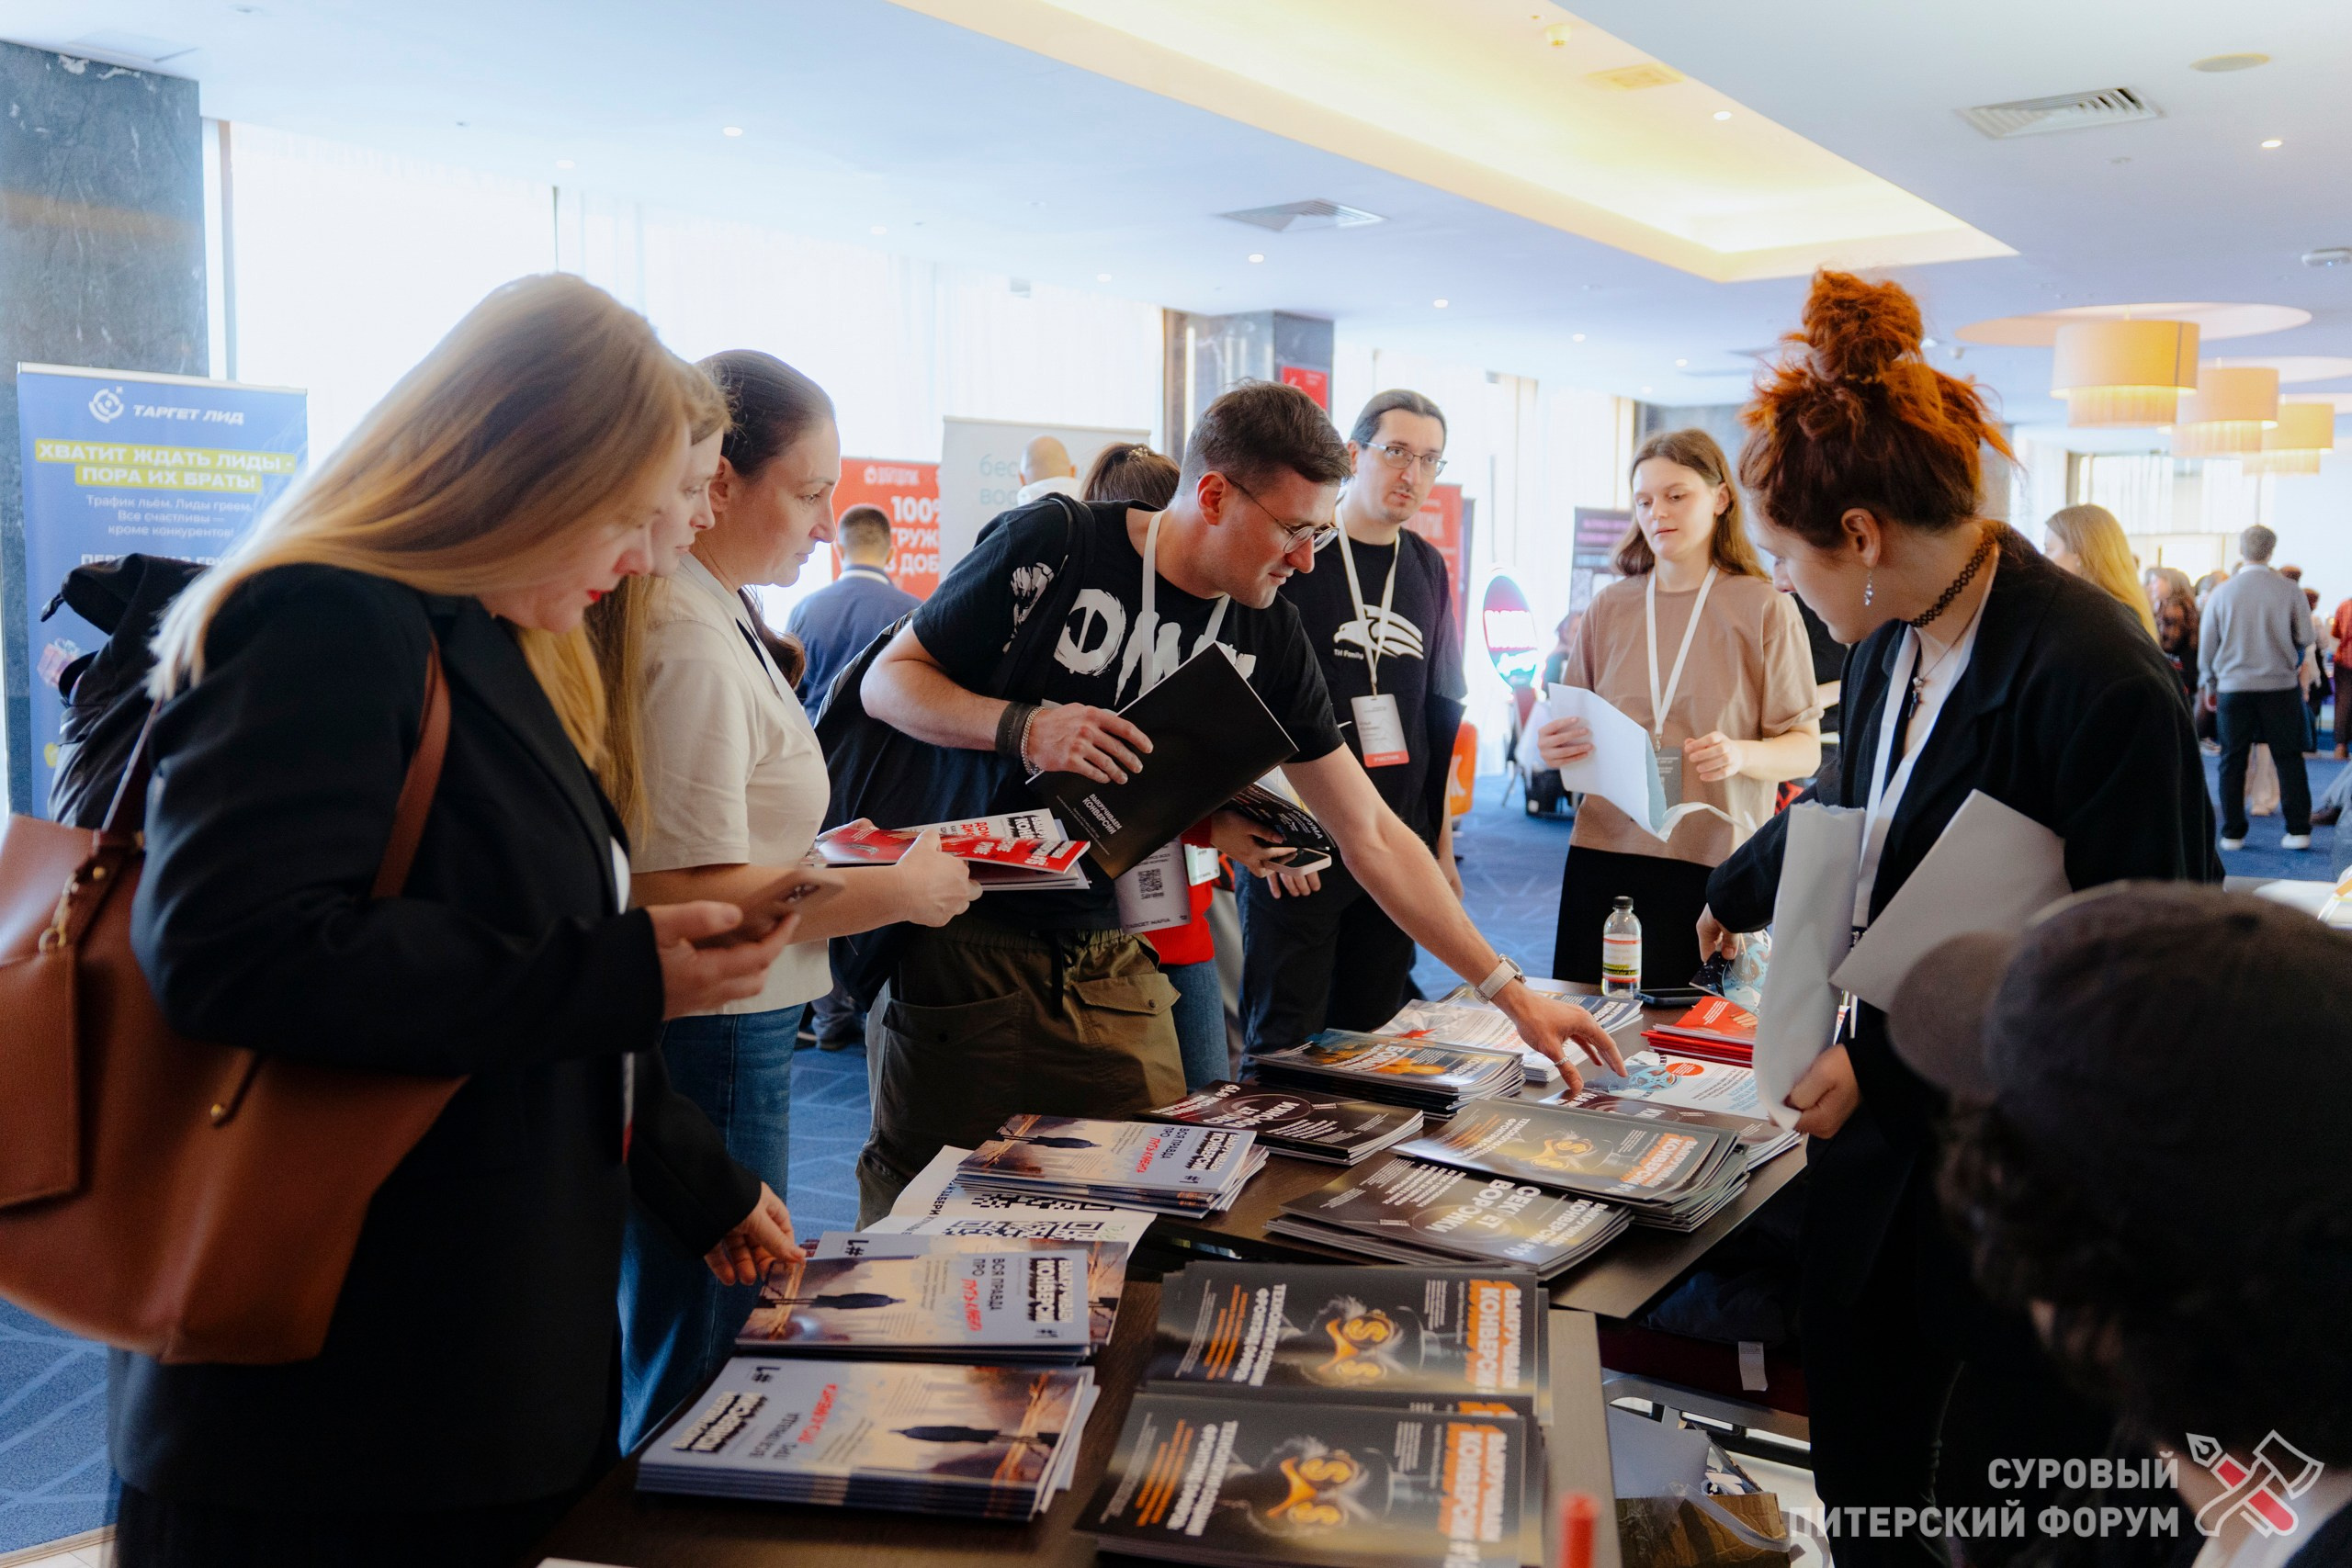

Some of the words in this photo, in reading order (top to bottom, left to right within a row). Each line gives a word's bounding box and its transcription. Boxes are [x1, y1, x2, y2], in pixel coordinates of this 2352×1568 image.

[133, 404, 200, 421] ТАРГЕТ
[202, 408, 244, 426] ЛИД
[39, 443, 128, 461] ХВАТИТ
[133, 448, 211, 468] ЖДАТЬ
[217, 454, 280, 471] ЛИДЫ
[82, 468, 141, 485] ПОРА
[148, 470, 177, 486] ИХ
[184, 472, 257, 490] БРАТЬ!
[86, 494, 134, 509] Трафик
[175, 499, 210, 511] Лиды
[118, 510, 141, 521] Все
[144, 512, 209, 524] счастливы
[107, 525, 149, 536] кроме
[152, 526, 233, 538] конкурентов!
[1082, 796, 1116, 836] КОНВЕРСИИ
[1089, 793, 1122, 830] ВЫКРУЧИВАЕМ
[1205, 1084, 1248, 1097] #19
[1222, 1100, 1305, 1129] ВОРОНКИ
[1157, 1126, 1175, 1137] ПРО
[1172, 1127, 1190, 1138] ВСЯ
[1158, 1138, 1183, 1159] ПРАВДА
[1188, 1133, 1227, 1171] КОНВЕРСИИ
[1206, 1134, 1241, 1172] ВЫКРУЧИВАЕМ
[1623, 1137, 1687, 1185] КОНВЕРСИИ
[1641, 1140, 1702, 1188] ВЫКРУЧИВАЕМ
[1427, 1179, 1515, 1234] ВОРОНКИ
[1523, 1199, 1592, 1247] КОНВЕРСИИ
[1544, 1202, 1609, 1248] ВЫКРУЧИВАЕМ
[1504, 1239, 1535, 1257] #19
[969, 1258, 986, 1276] ПРО
[989, 1258, 1005, 1276] ВСЯ
[987, 1278, 1005, 1310] ПРАВДА
[1033, 1259, 1057, 1323] КОНВЕРСИИ
[1056, 1259, 1074, 1323] ВЫКРУЧИВАЕМ
[1256, 1283, 1288, 1348] ТЕХНОЛОГИЯ
[1474, 1287, 1500, 1387] КОНВЕРСИИ
[1500, 1289, 1521, 1388] ВЫКРУЧИВАЕМ
[755, 1365, 781, 1383] #1
[1448, 1430, 1482, 1540] КОНВЕРСИИ
